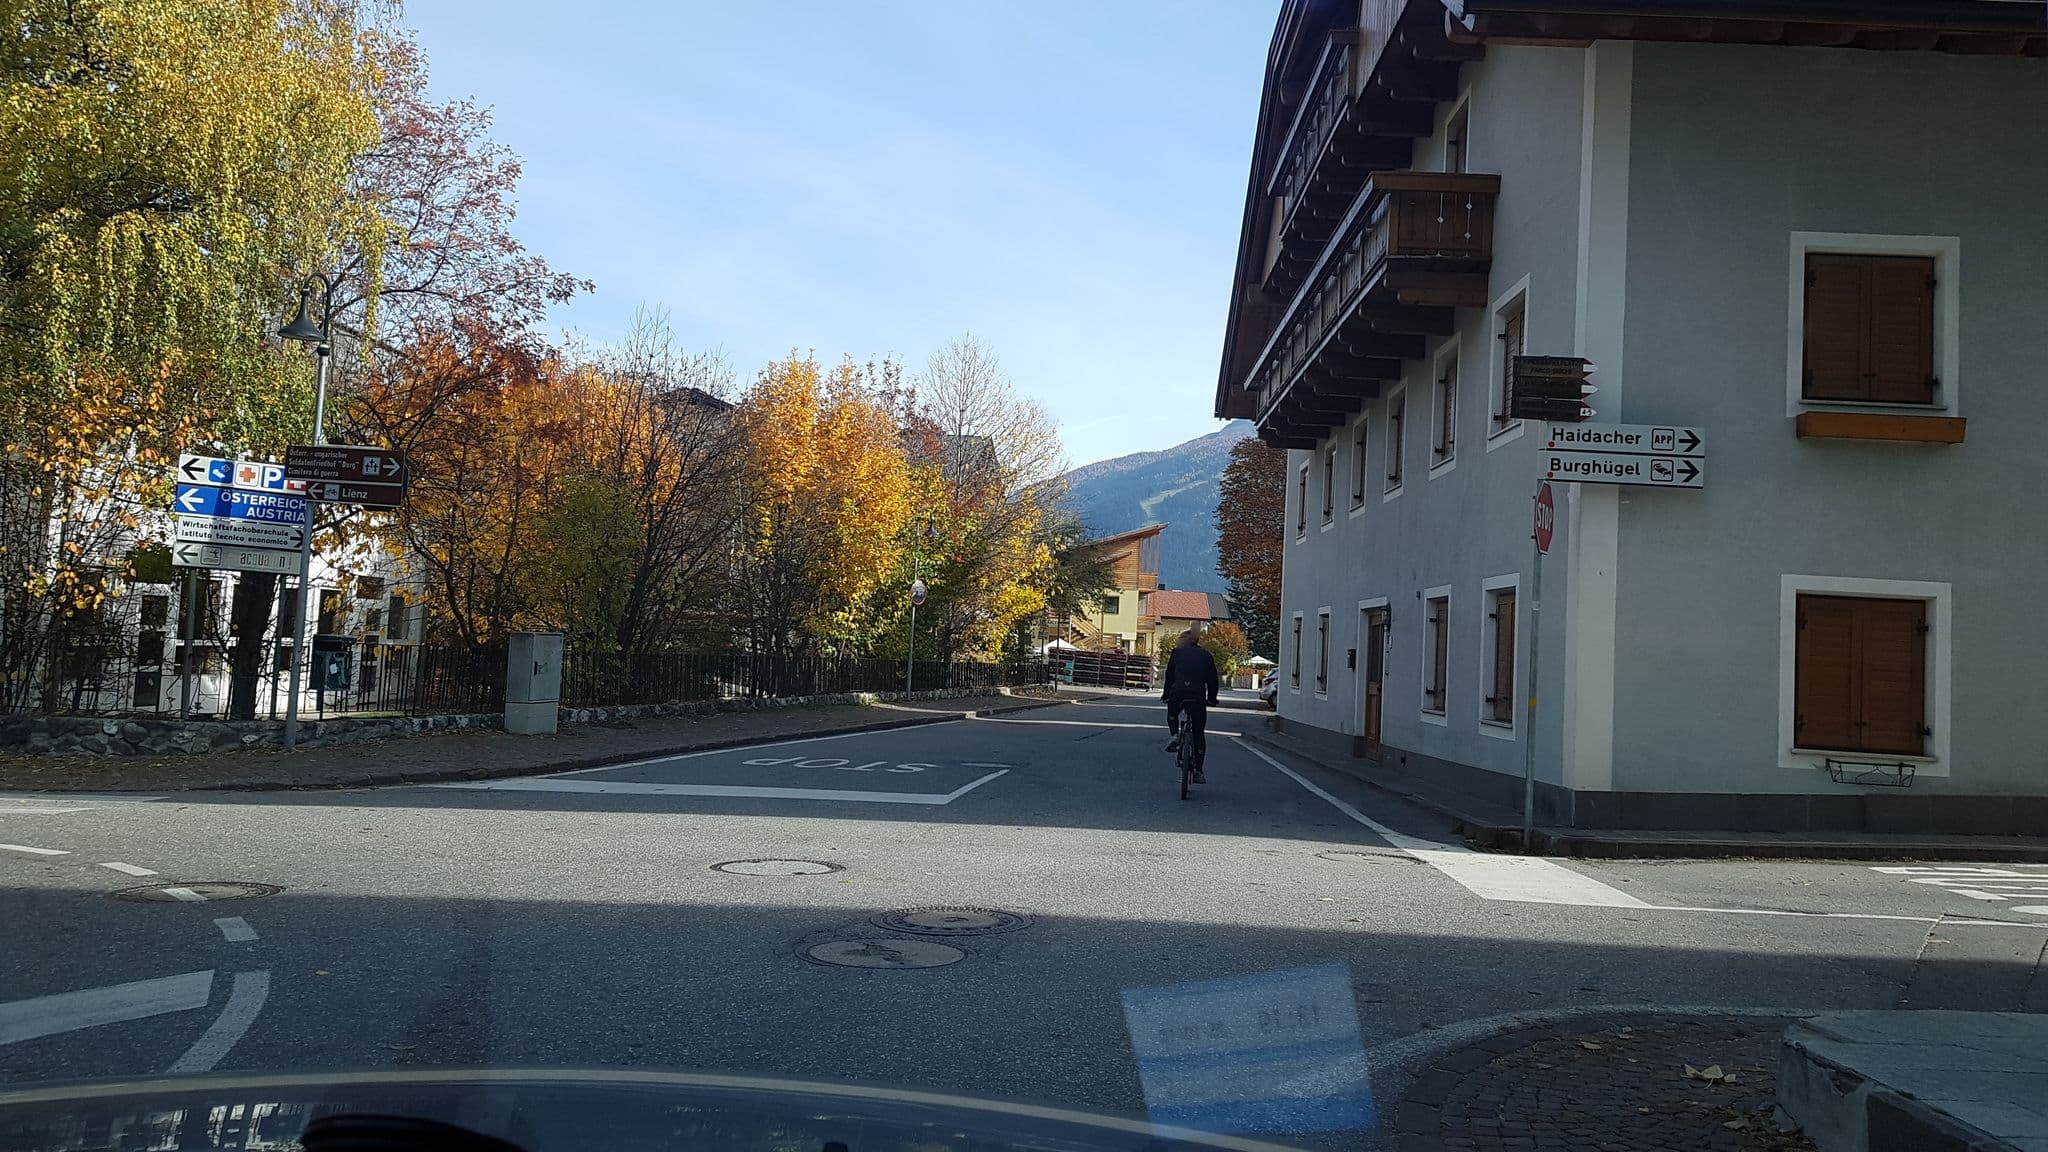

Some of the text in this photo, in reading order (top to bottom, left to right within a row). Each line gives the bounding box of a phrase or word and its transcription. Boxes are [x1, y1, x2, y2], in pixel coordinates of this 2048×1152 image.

[1552, 427, 1642, 445] Haidacher
[1654, 434, 1672, 445] APP
[289, 458, 337, 467] Soldatenfriedhof
[314, 451, 348, 459] ungarischer
[288, 467, 339, 478] Cimitero di guerra
[1550, 457, 1640, 477] Burghügel
[263, 467, 282, 488] P
[221, 489, 307, 510] ÖSTERREICH
[342, 487, 368, 499] Lienz
[246, 507, 305, 522] AUSTRIA
[1537, 502, 1553, 532] STOP
[182, 520, 289, 537] Wirtschaftsfachoberschule
[216, 533, 244, 542] tecnico
[248, 537, 288, 546] economico
[742, 756, 941, 773] STOP
